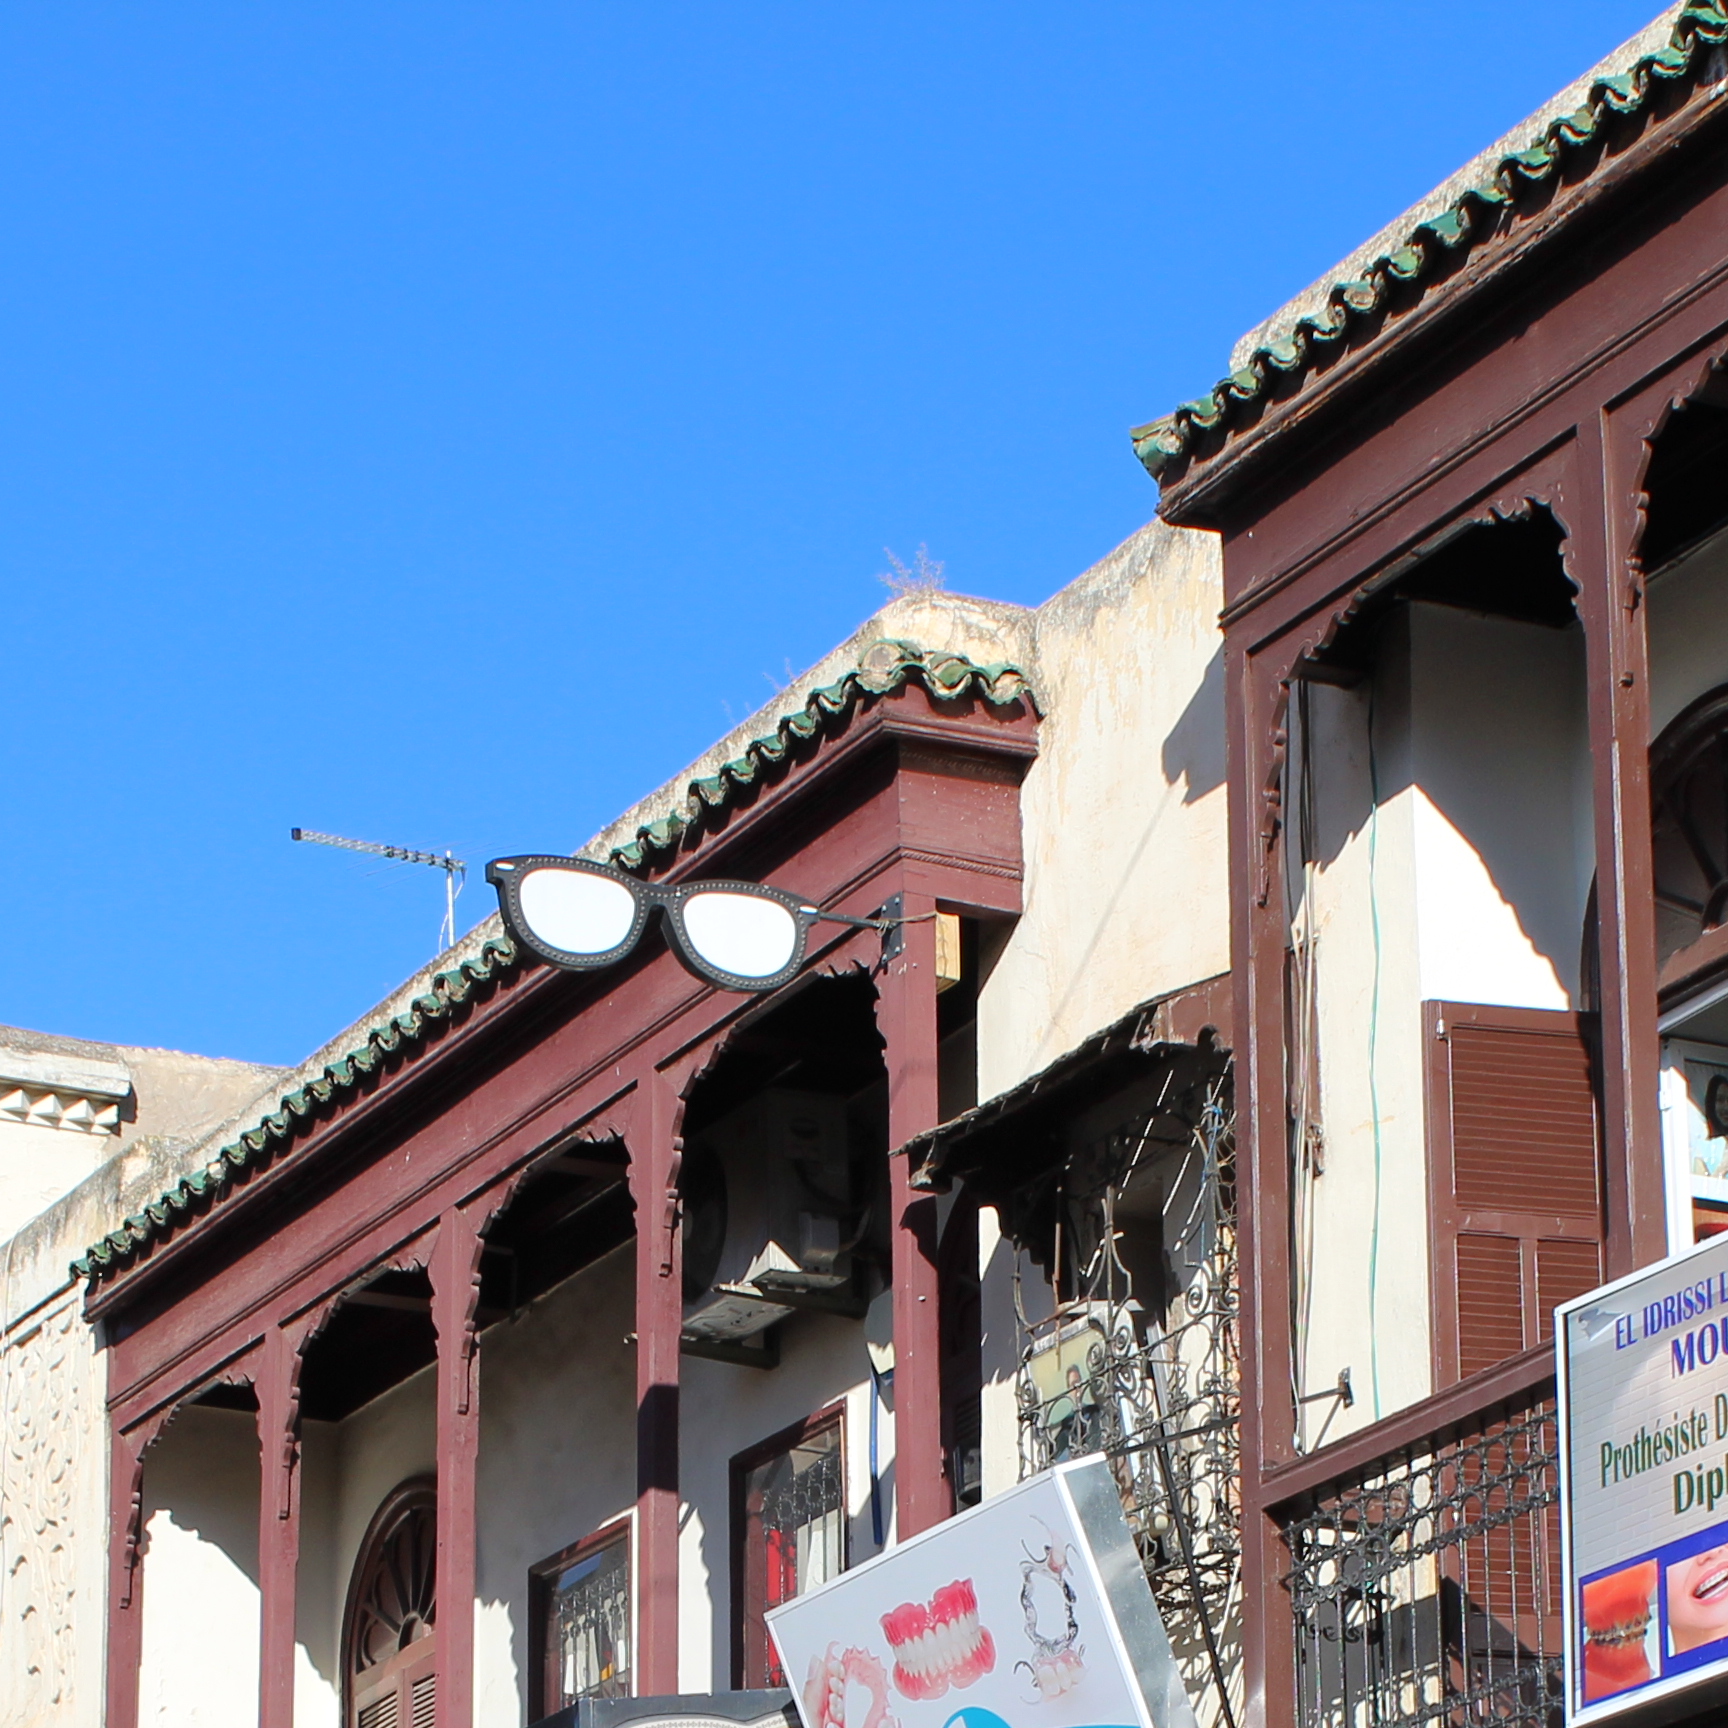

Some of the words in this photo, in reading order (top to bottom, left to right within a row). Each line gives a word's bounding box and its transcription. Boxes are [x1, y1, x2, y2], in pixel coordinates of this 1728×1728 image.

[1615, 1313, 1637, 1350] EL
[1642, 1278, 1713, 1339] IDRISSI
[1601, 1406, 1708, 1488] Prothésiste
